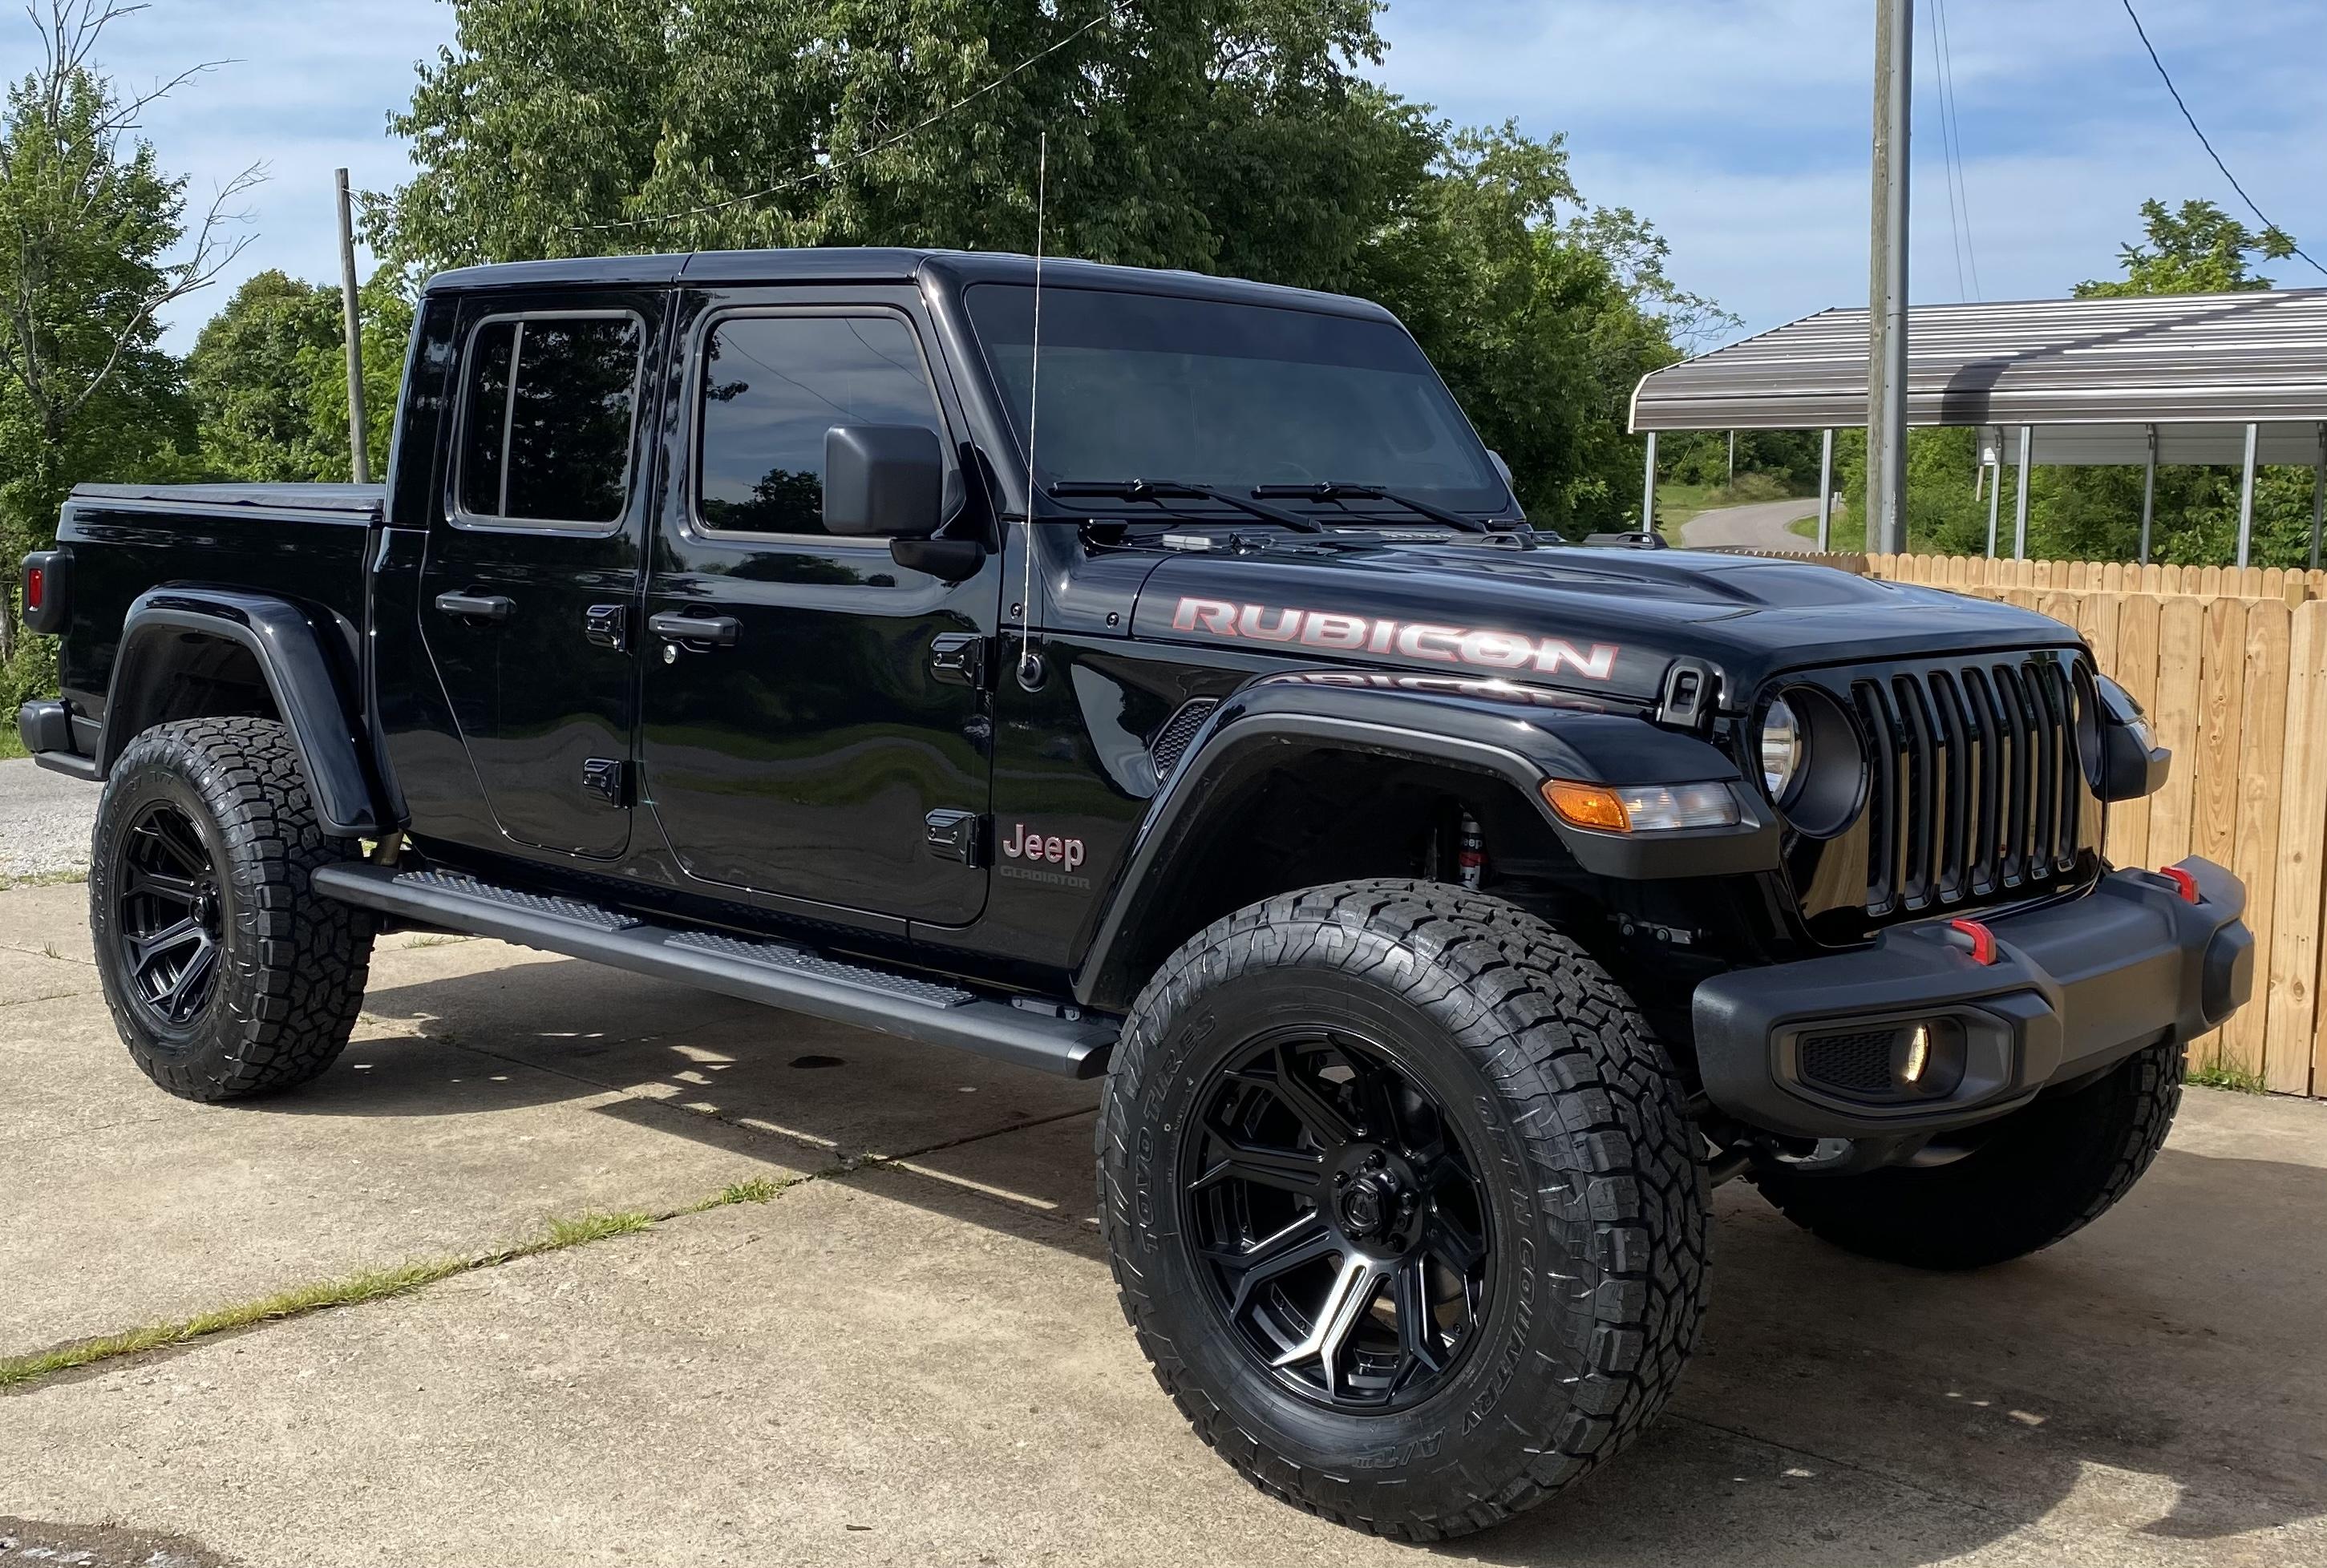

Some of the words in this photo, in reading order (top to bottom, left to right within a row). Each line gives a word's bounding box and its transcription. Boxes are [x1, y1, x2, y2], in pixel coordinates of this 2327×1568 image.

[1172, 596, 1620, 681] RUBICON
[1000, 865, 1091, 890] GLADIATOR
[1002, 823, 1087, 872] Jeep
[1143, 1003, 1217, 1123] TIRES
[1135, 1126, 1159, 1255] TOYO
[1461, 1237, 1537, 1437] COUNTRY
